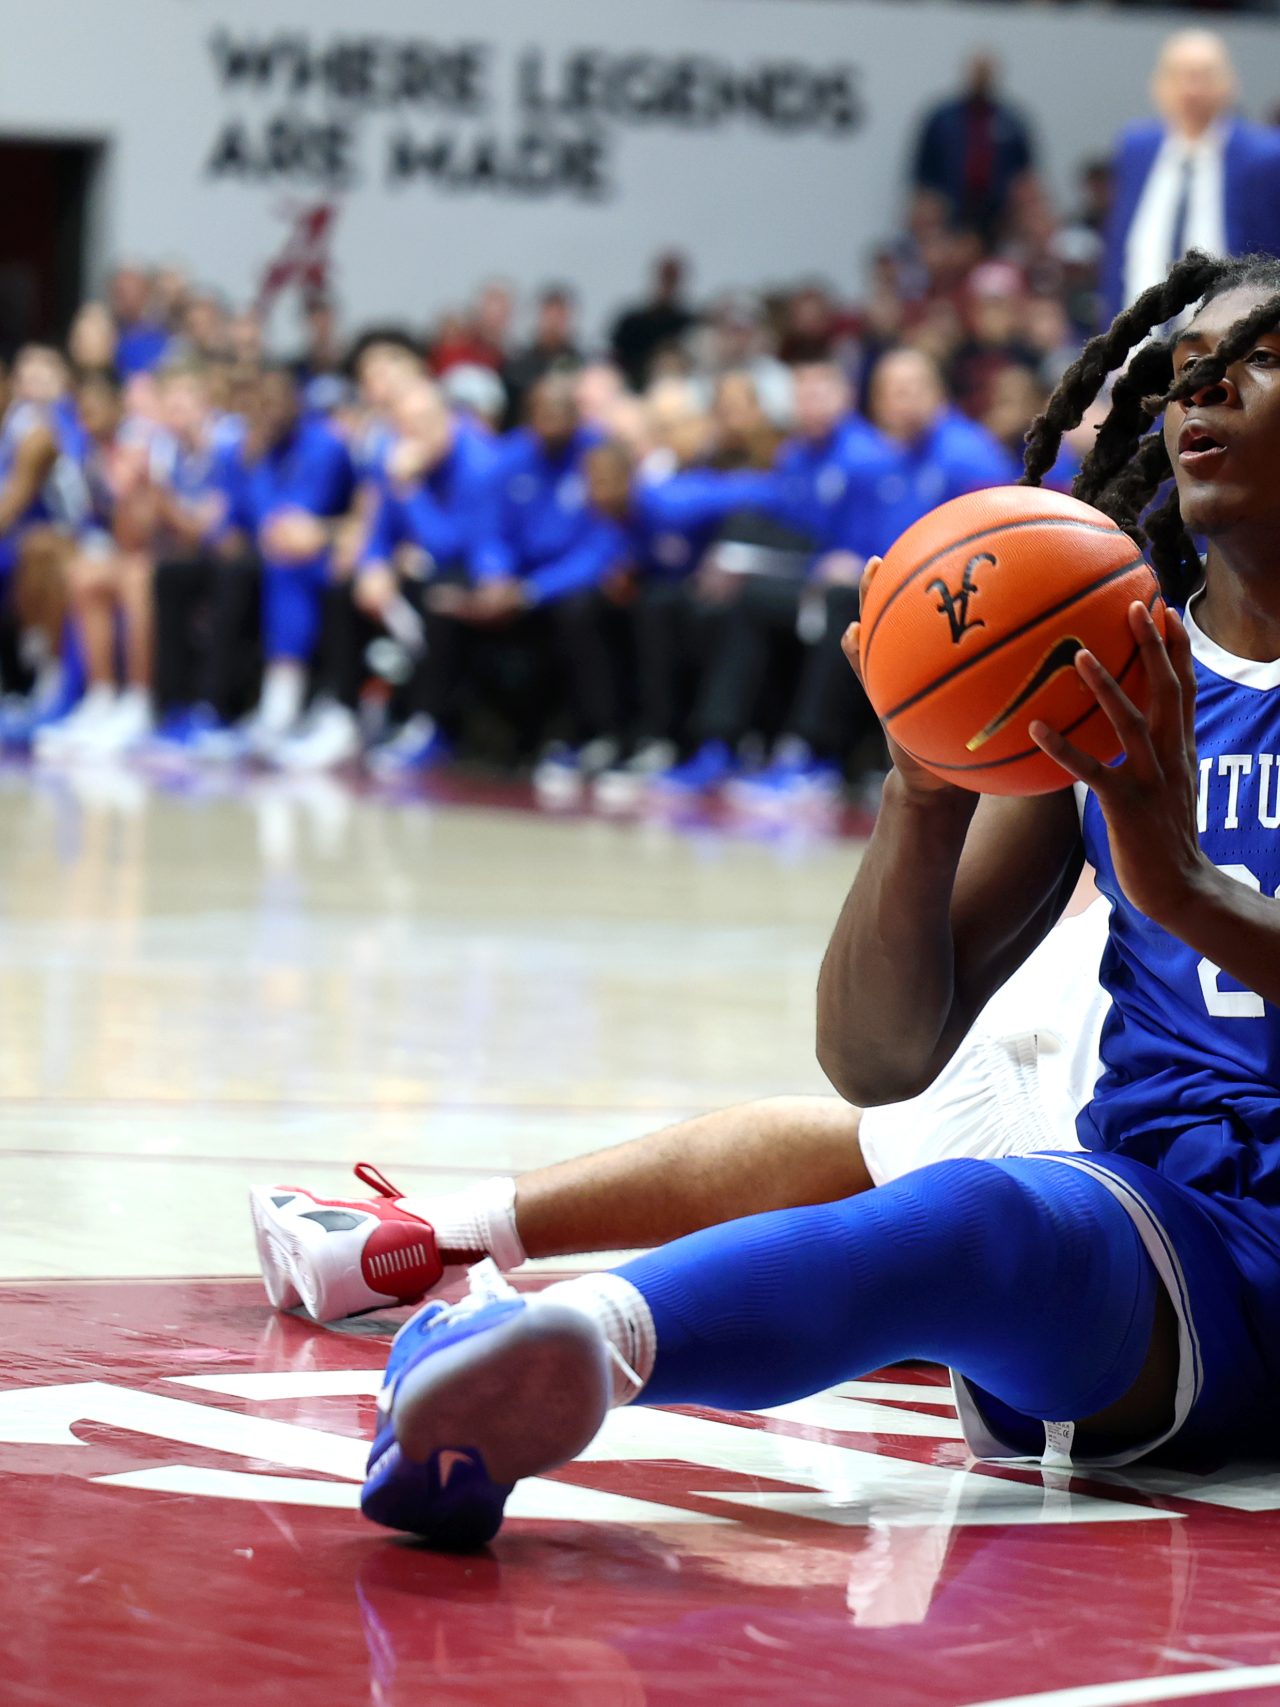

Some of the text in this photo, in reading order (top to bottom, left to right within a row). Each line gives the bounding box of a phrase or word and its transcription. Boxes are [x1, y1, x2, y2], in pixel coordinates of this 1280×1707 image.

[211, 28, 862, 137] WHERE LEGENDS
[208, 114, 610, 205] ARE MADE
